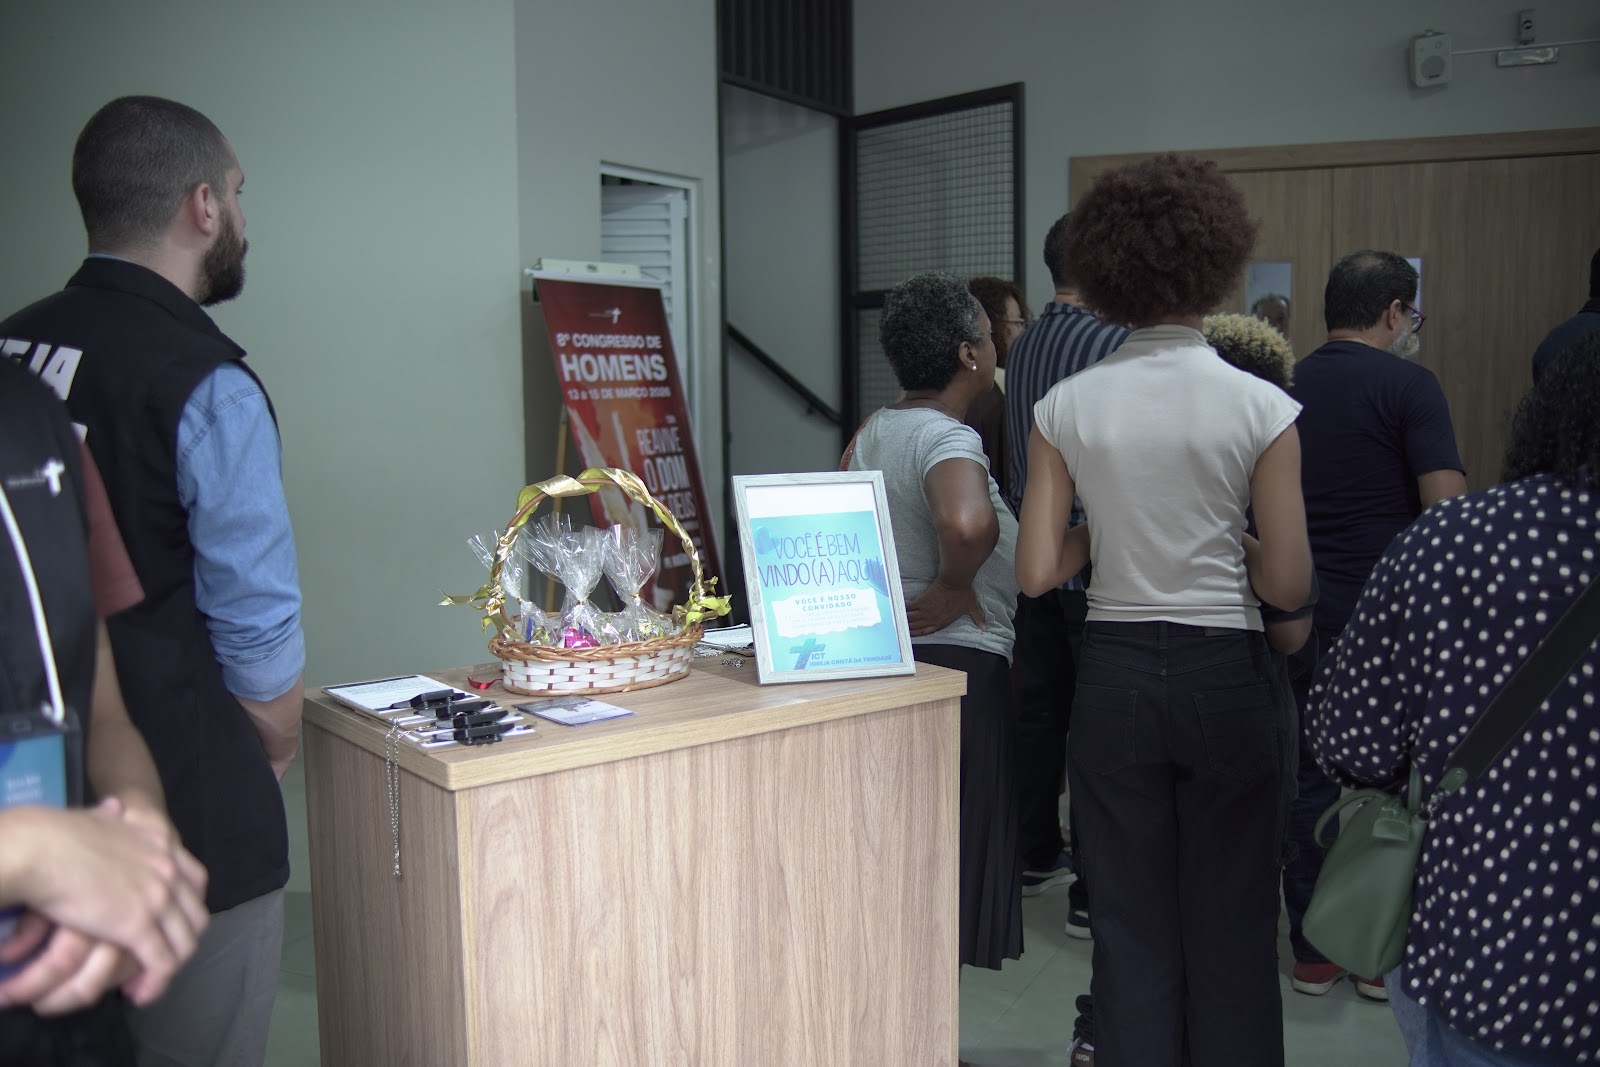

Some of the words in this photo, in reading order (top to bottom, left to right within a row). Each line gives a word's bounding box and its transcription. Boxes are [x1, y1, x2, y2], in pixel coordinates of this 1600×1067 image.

[572, 333, 645, 348] CONGRESSO
[646, 335, 662, 349] DE
[560, 353, 668, 382] HOMENS
[601, 388, 613, 399] DE
[616, 387, 648, 400] MARÇO
[637, 427, 682, 455] REAVIVE
[643, 459, 657, 492] O
[657, 454, 690, 491] DOM
[668, 491, 696, 520] DEUS
[771, 532, 817, 560] VOCÊ
[815, 531, 827, 557] É
[826, 533, 861, 557] BEM
[758, 557, 835, 588] VINDO(A)
[802, 601, 852, 612] CONVIDADO
[828, 593, 857, 602] NOSSO
[811, 652, 826, 660] ICT
[831, 657, 853, 665] CRISTÃ
[863, 654, 892, 662] TRINDADE
